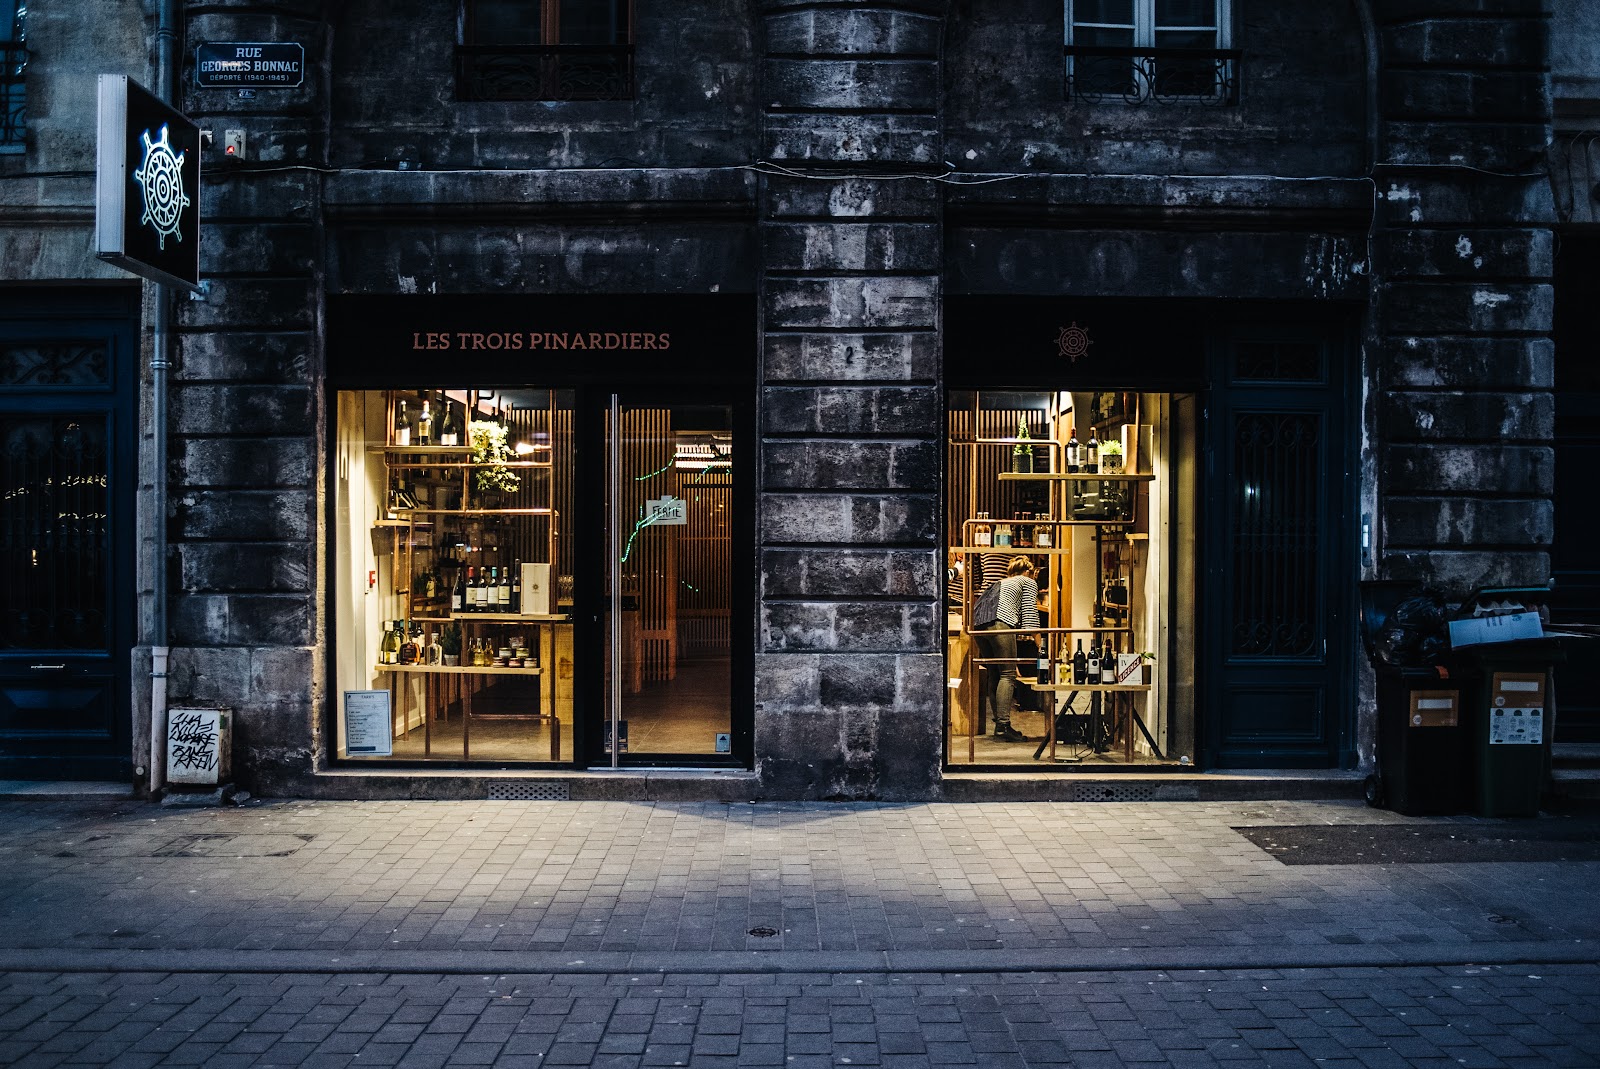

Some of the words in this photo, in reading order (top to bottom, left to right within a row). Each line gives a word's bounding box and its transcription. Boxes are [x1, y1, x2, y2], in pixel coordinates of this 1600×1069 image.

[236, 47, 262, 58] RUE
[201, 61, 251, 72] GEORGES
[254, 61, 299, 72] BONNAC
[209, 73, 241, 81] DÉPORTÉ
[413, 333, 450, 350] LES
[457, 333, 523, 350] TROIS
[529, 333, 670, 350] PINARDIERS
